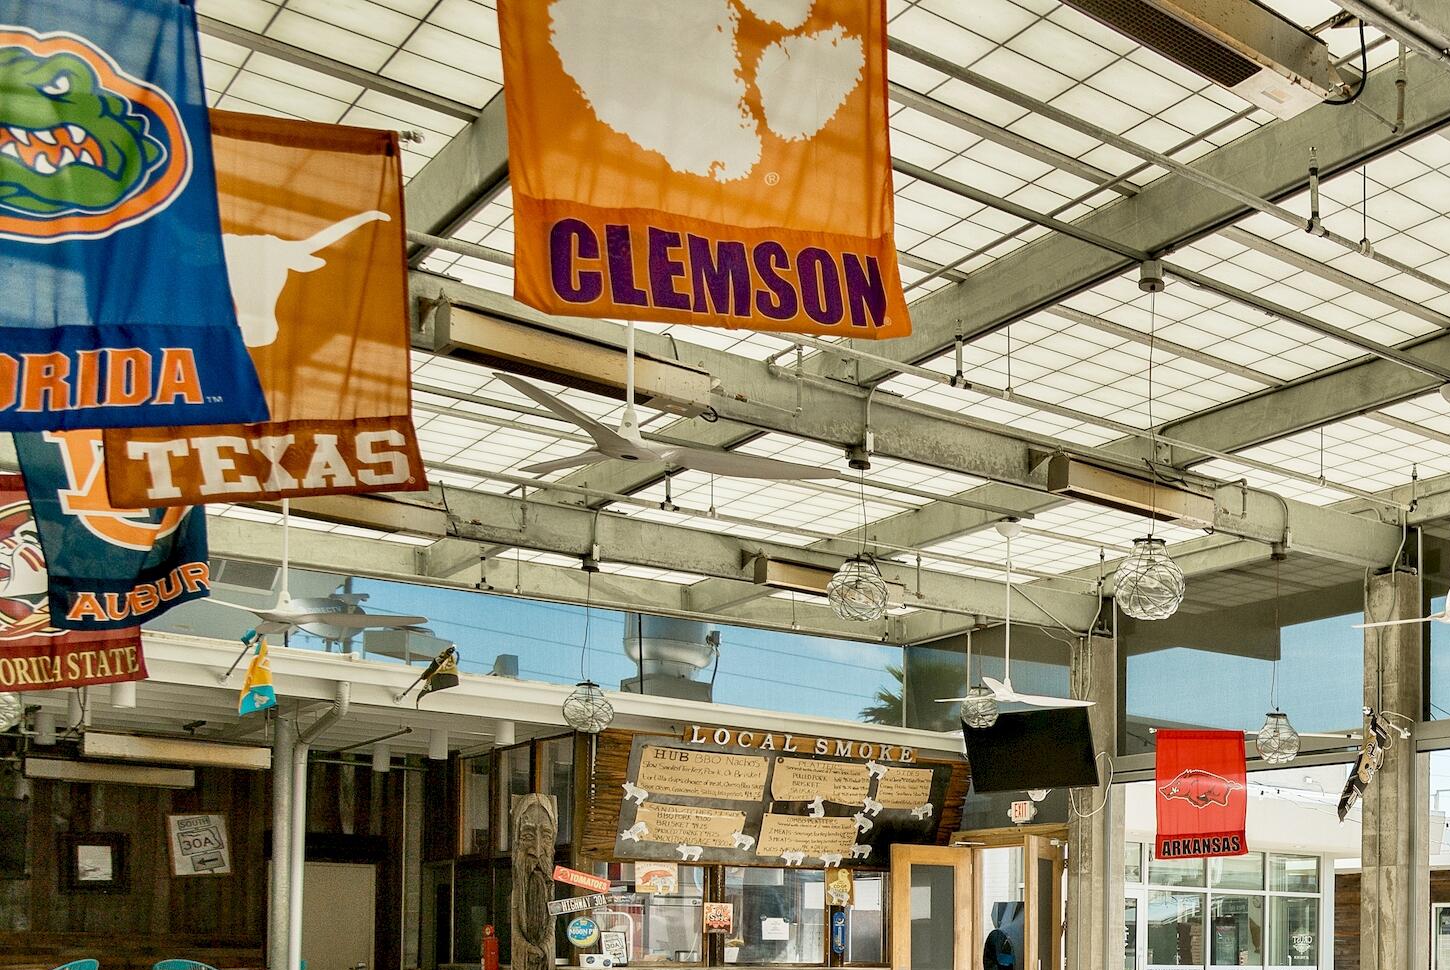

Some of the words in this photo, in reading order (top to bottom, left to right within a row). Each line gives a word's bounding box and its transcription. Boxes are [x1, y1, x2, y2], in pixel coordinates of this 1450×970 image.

[549, 217, 888, 329] CLEMSON
[126, 429, 412, 499] TEXAS
[67, 645, 140, 680] STATE
[691, 725, 798, 752] LOCAL
[814, 739, 914, 763] SMOKE
[653, 748, 689, 762] HUB
[725, 756, 761, 768] Nachos
[1014, 802, 1027, 818] EXIT
[180, 818, 209, 829] SOUTH
[656, 820, 689, 828] BRISKET
[182, 837, 214, 850] 30A
[1161, 835, 1241, 857] ARKANSAS
[569, 873, 608, 891] TOMATOES
[561, 897, 591, 912] HIGHWAY
[593, 894, 607, 906] 30A
